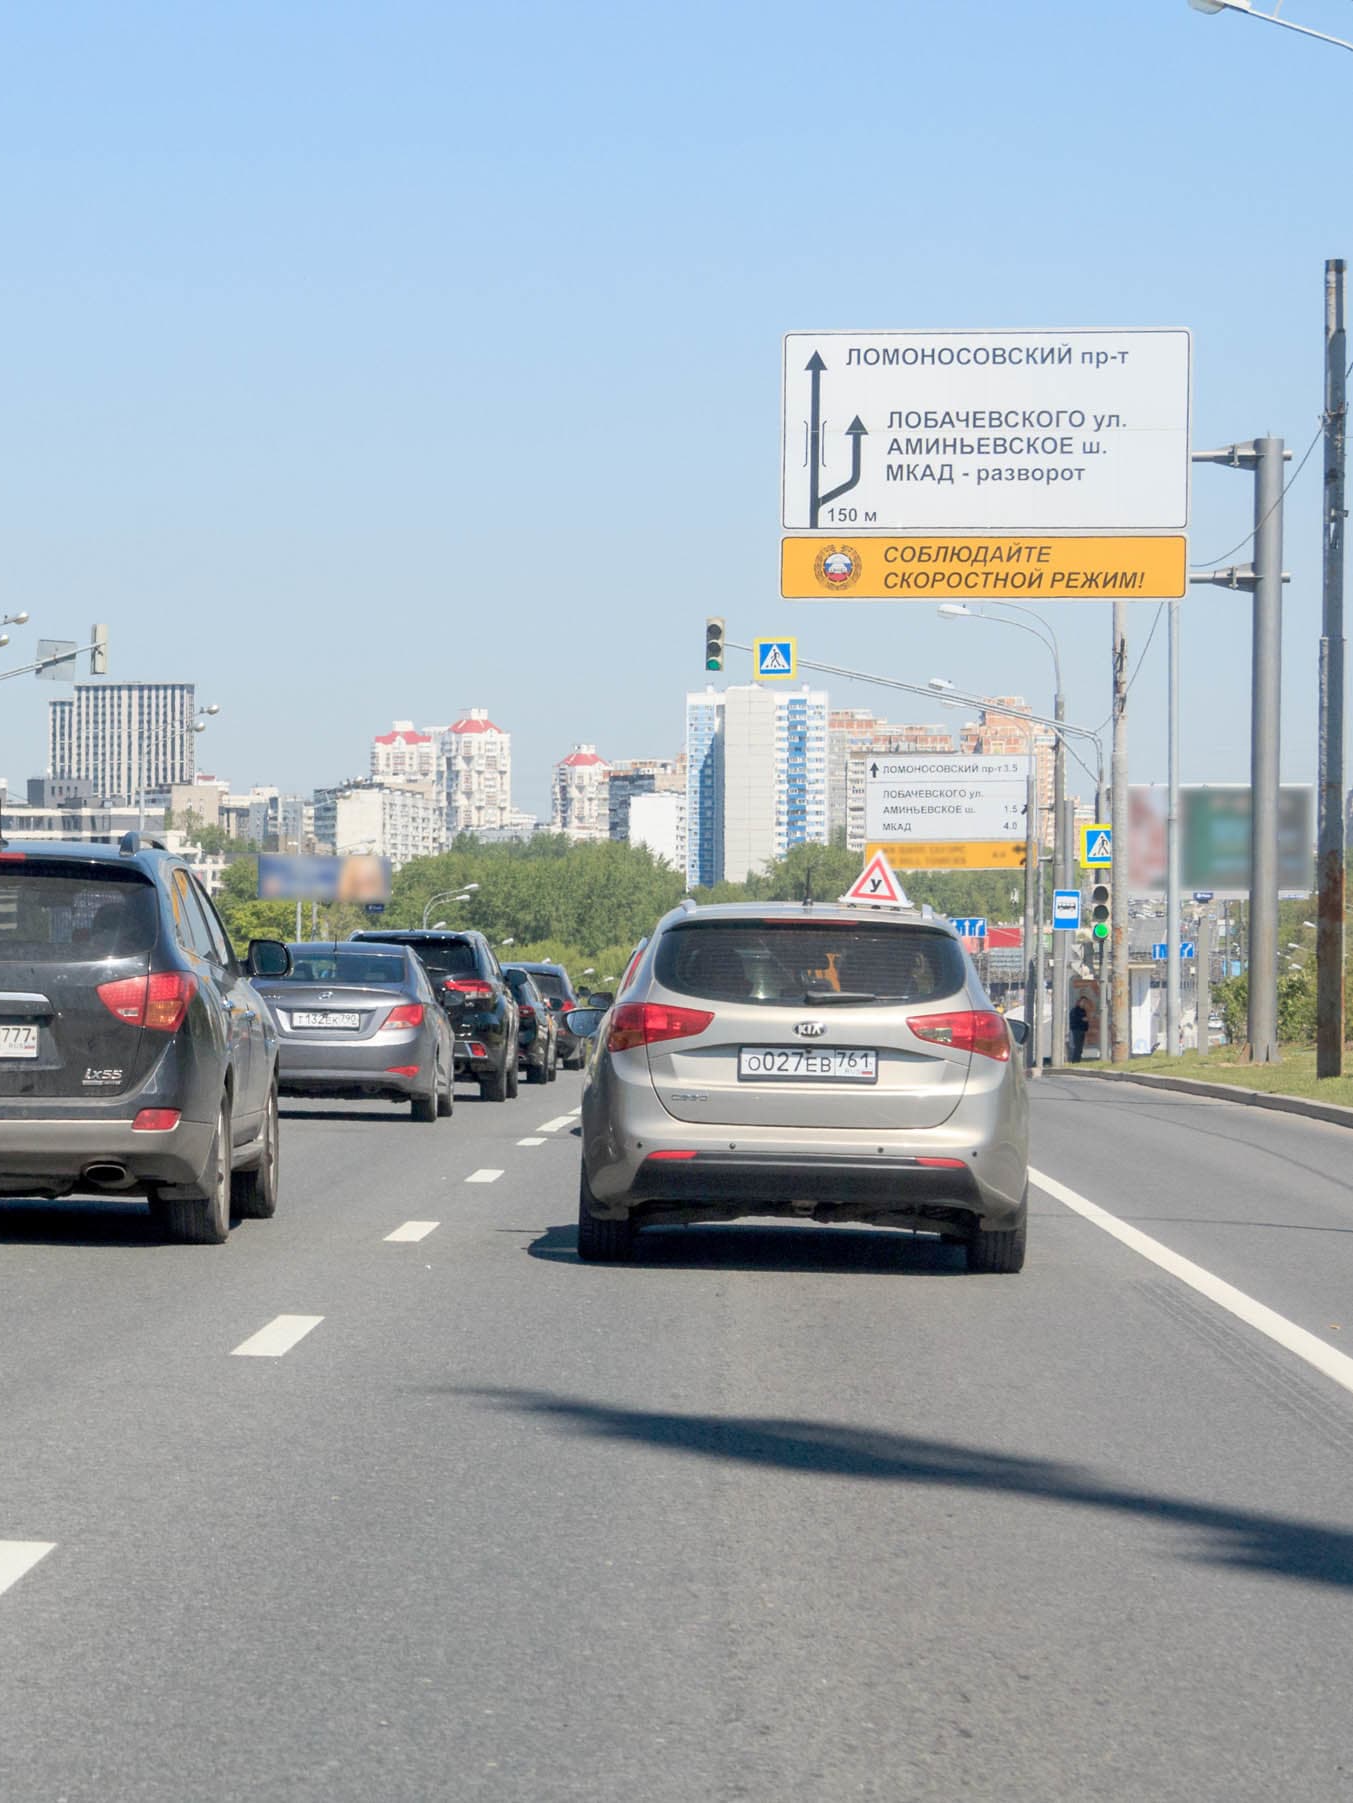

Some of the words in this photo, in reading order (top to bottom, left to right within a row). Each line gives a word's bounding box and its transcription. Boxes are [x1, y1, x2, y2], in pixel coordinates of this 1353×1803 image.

[846, 344, 1073, 367] ЛОМОНОСОВСКИЙ
[1081, 350, 1129, 369] пр-т
[887, 410, 1086, 430] ЛОБАЧЕВСКОГО
[1093, 414, 1128, 434] ул.
[887, 436, 1074, 456] АМИНЬЕВСКОЕ
[1082, 441, 1108, 455] ш.
[886, 463, 955, 484] МКАД
[976, 466, 1086, 486] разворот
[826, 507, 859, 523] 150
[865, 511, 878, 523] м
[883, 545, 1052, 565] СОБЛЮДАЙТЕ
[883, 570, 1044, 590] СКОРОСТНОЙ
[1050, 571, 1145, 590] РЕЖИМ!
[882, 765, 979, 775] ЛОМОНОСОВСКИЙ
[882, 790, 967, 799] ЛОБАЧЕВСКОГО
[883, 806, 962, 815] АМИНЬЕВСКОЕ
[882, 823, 912, 832] МКАД
[1003, 823, 1018, 831] 4.0
[1, 1027, 32, 1043] 777
[797, 1023, 823, 1036] KIA
[837, 1051, 870, 1068] 761
